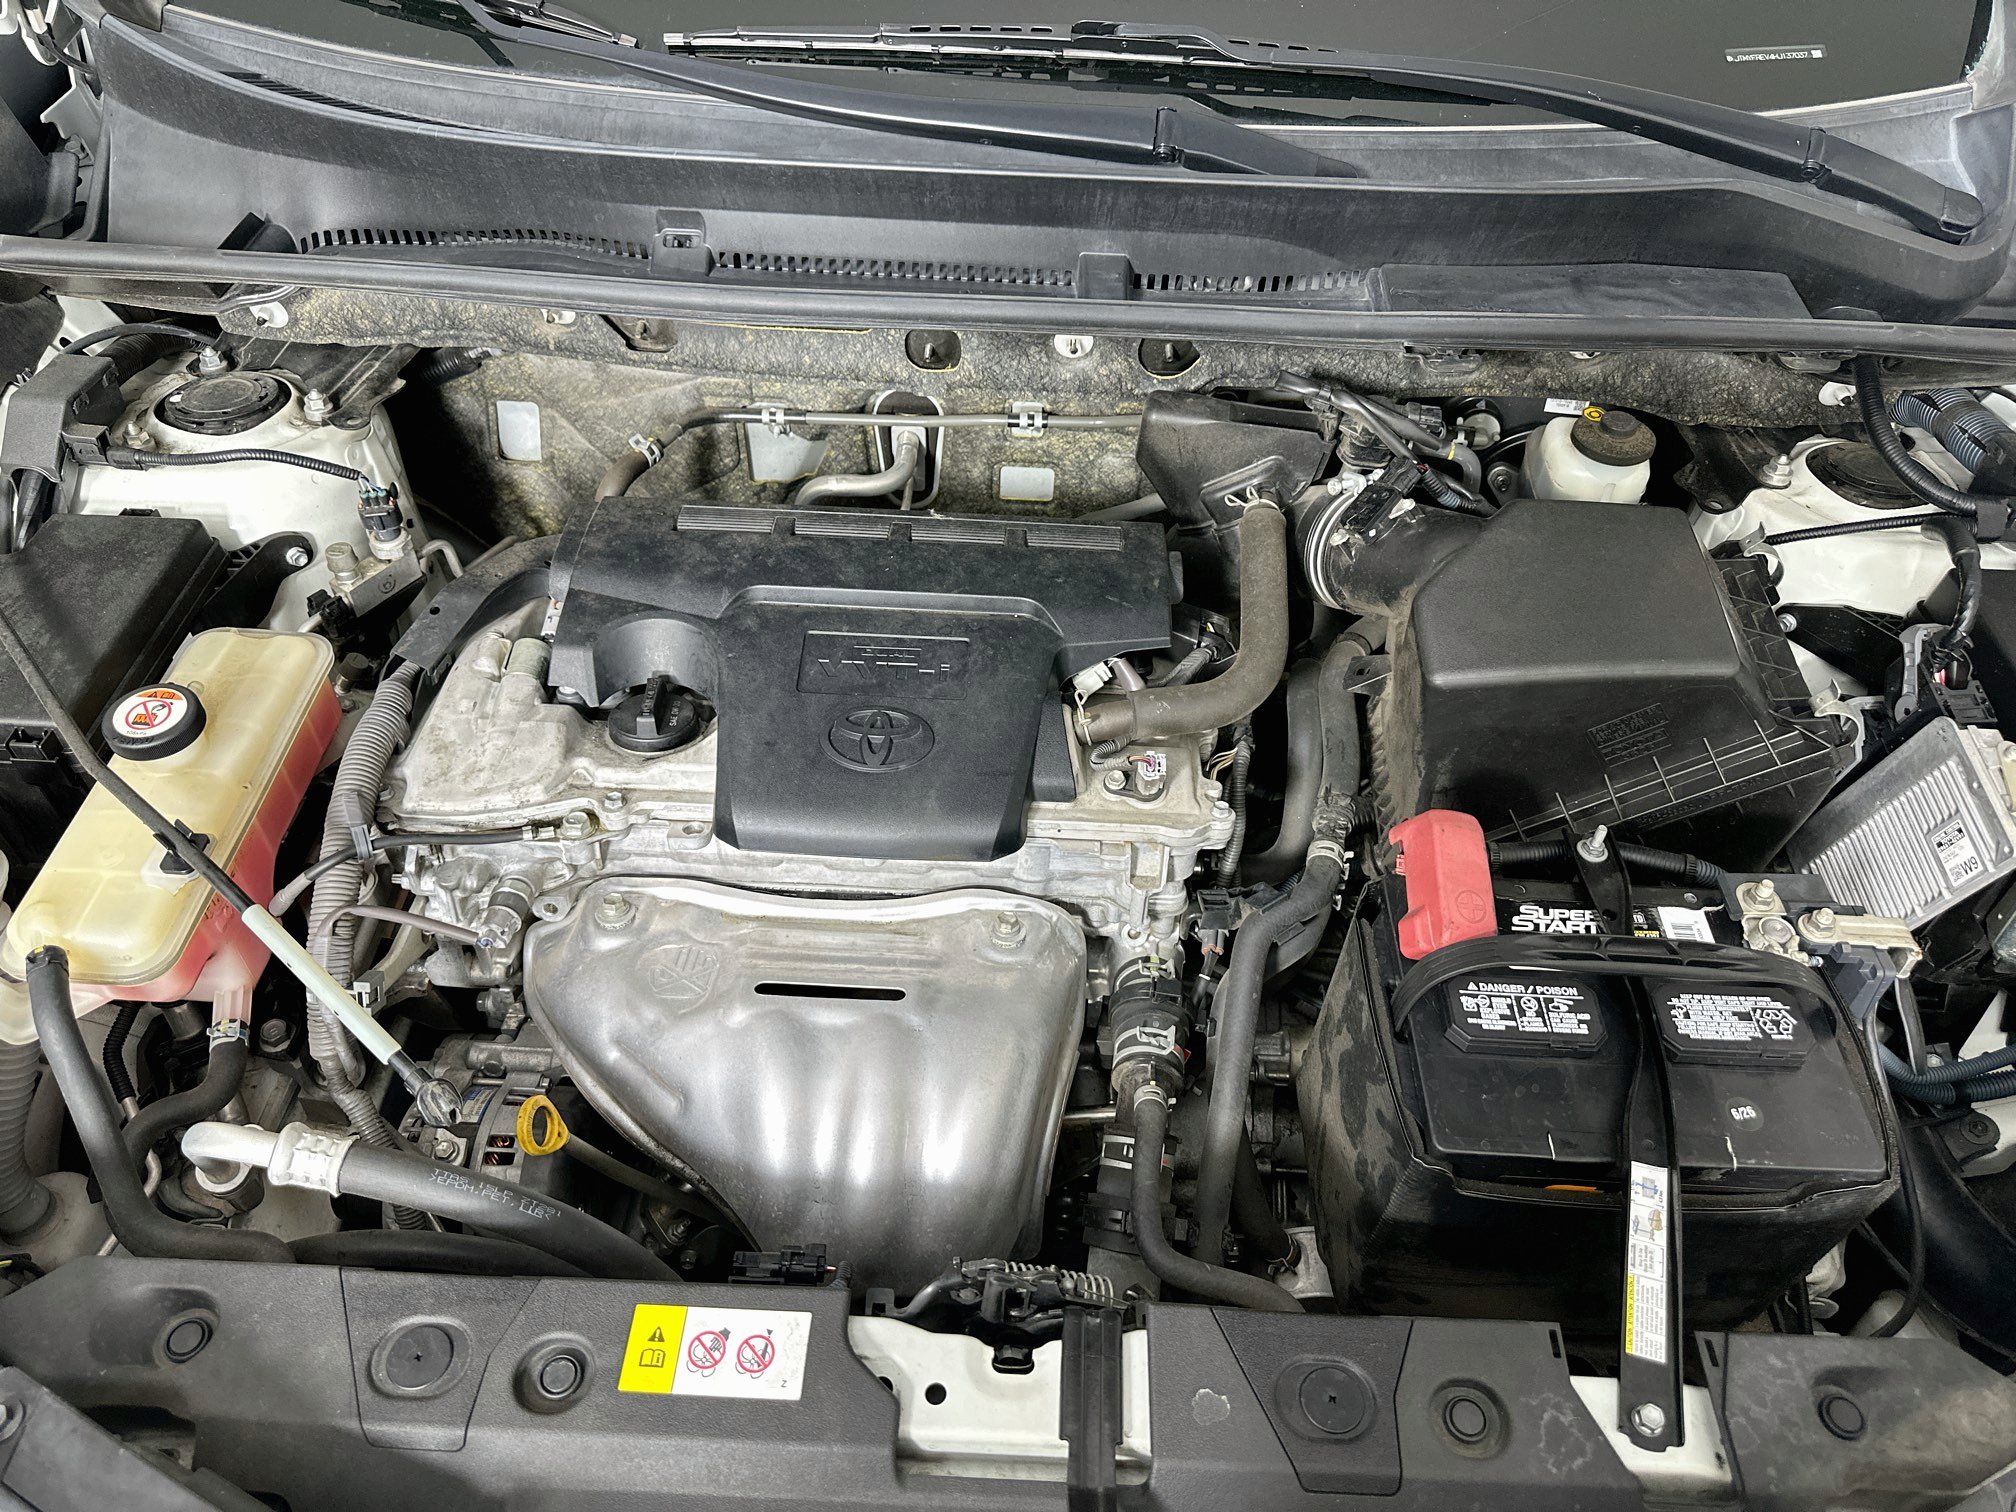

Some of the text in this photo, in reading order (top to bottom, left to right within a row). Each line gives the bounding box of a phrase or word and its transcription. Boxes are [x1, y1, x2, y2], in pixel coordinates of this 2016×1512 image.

[1960, 856, 1979, 875] W9
[1511, 915, 1597, 934] START
[1479, 982, 1578, 996] DANGER / POISON
[1730, 1105, 1756, 1120] 6/26
